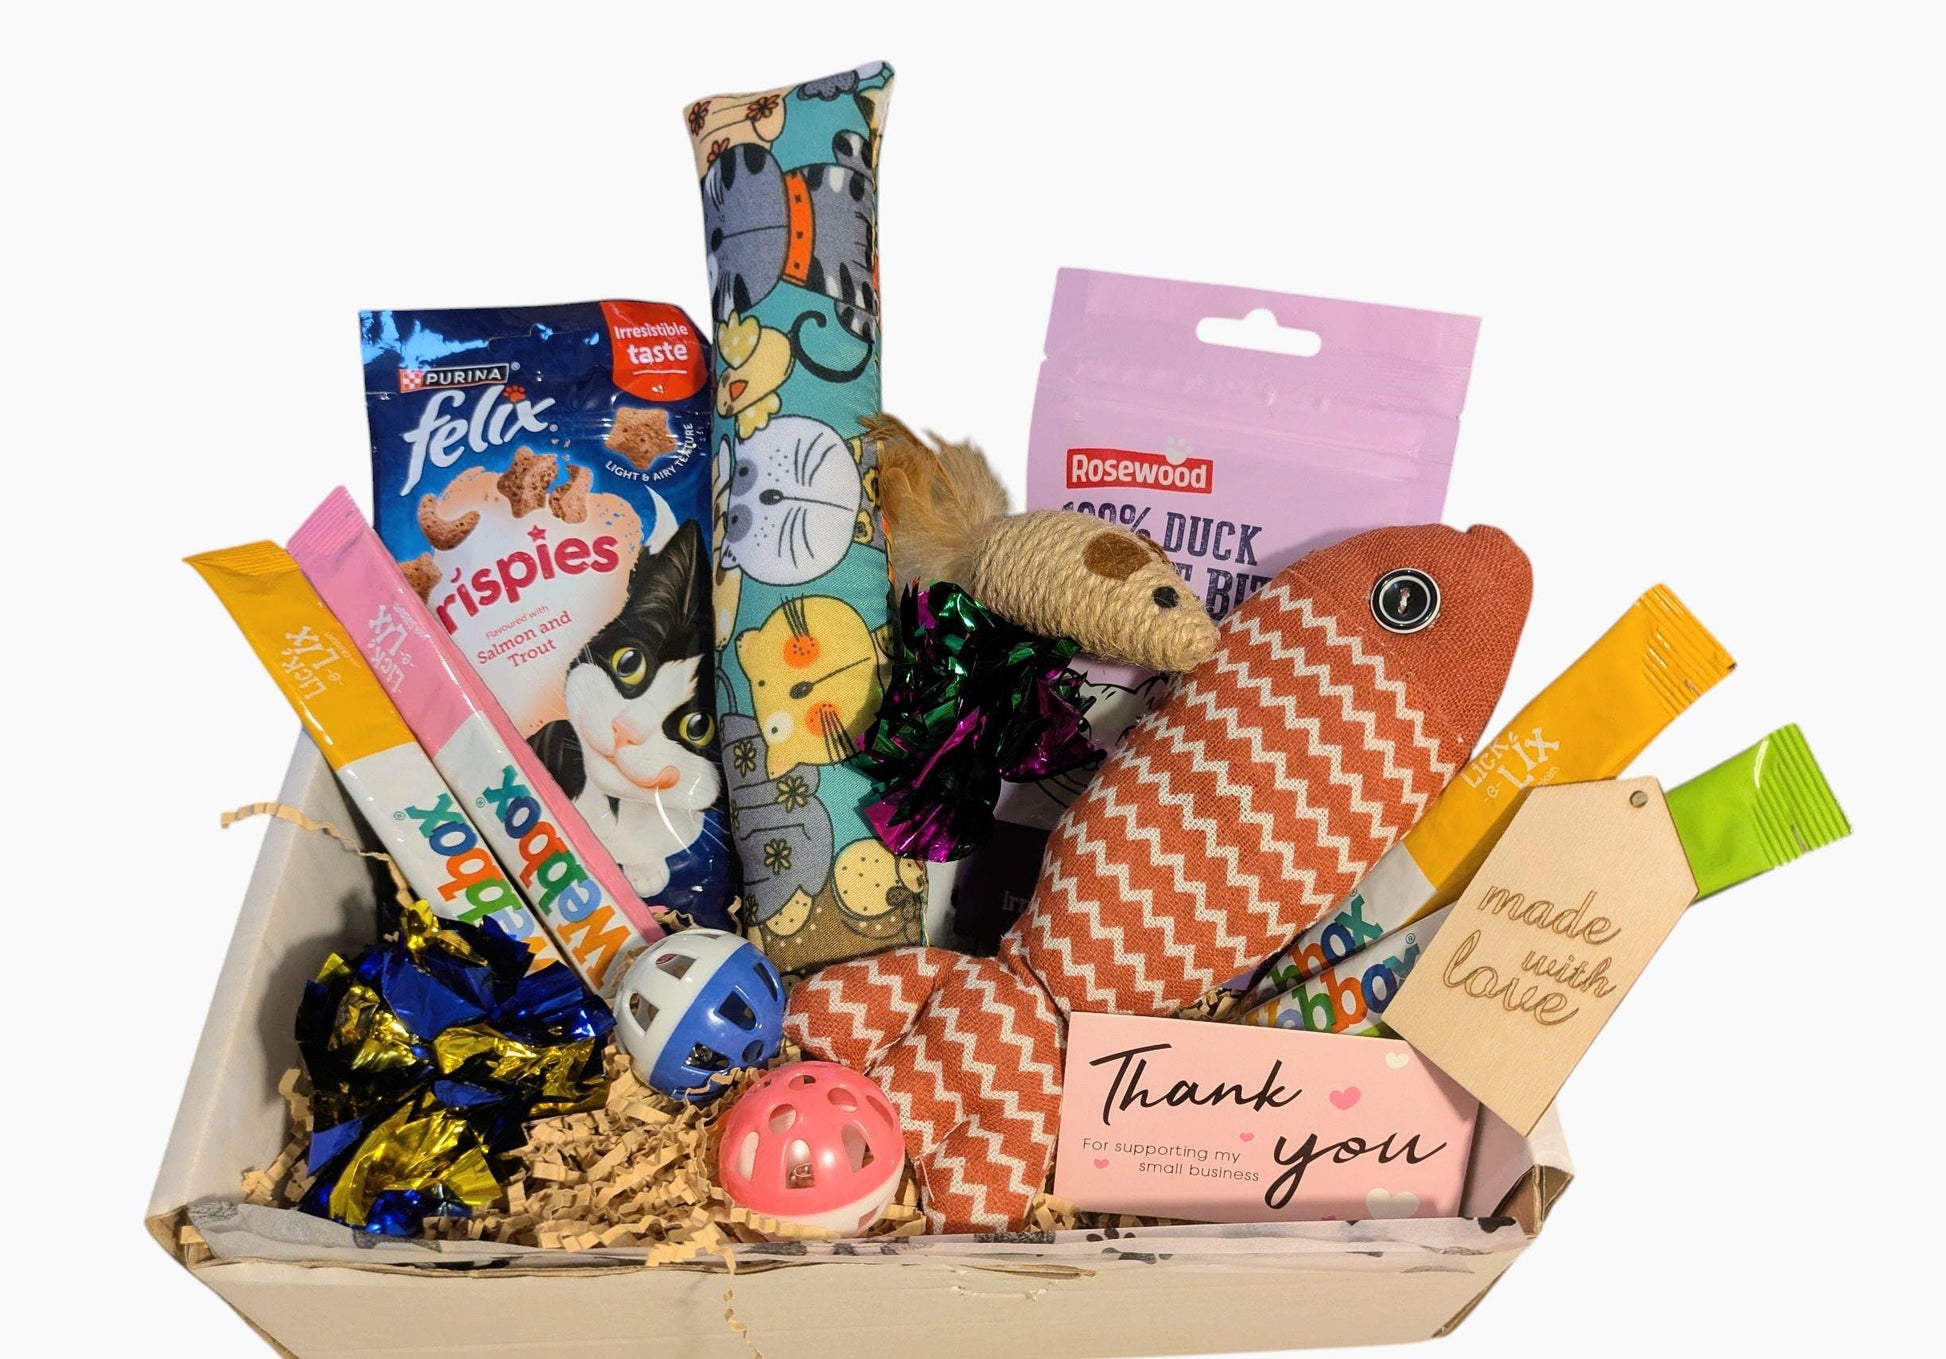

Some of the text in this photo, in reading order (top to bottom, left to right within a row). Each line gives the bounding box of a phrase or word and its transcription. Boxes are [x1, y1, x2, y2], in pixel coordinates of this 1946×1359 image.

[613, 322, 689, 340] Irresistible
[627, 342, 689, 365] taste
[425, 367, 504, 386] PURINA
[401, 384, 555, 496] felix
[605, 460, 640, 481] LIGHT
[641, 473, 650, 482] &
[653, 465, 677, 482] AIRY
[1071, 454, 1207, 489] Rosewood
[1163, 511, 1263, 566] DUCK
[435, 525, 620, 636] rispies
[477, 611, 573, 665] Salmon and
[486, 605, 550, 640] Flavoured with
[508, 640, 557, 669] Trout
[482, 765, 631, 990] Webbox
[1477, 885, 1622, 945] made
[1442, 929, 1580, 1026] love
[1521, 950, 1617, 998] with
[1088, 1043, 1303, 1126] Thank
[1083, 1137, 1241, 1164] For supporting my
[1138, 1160, 1260, 1182] small business
[1264, 1131, 1448, 1210] you
